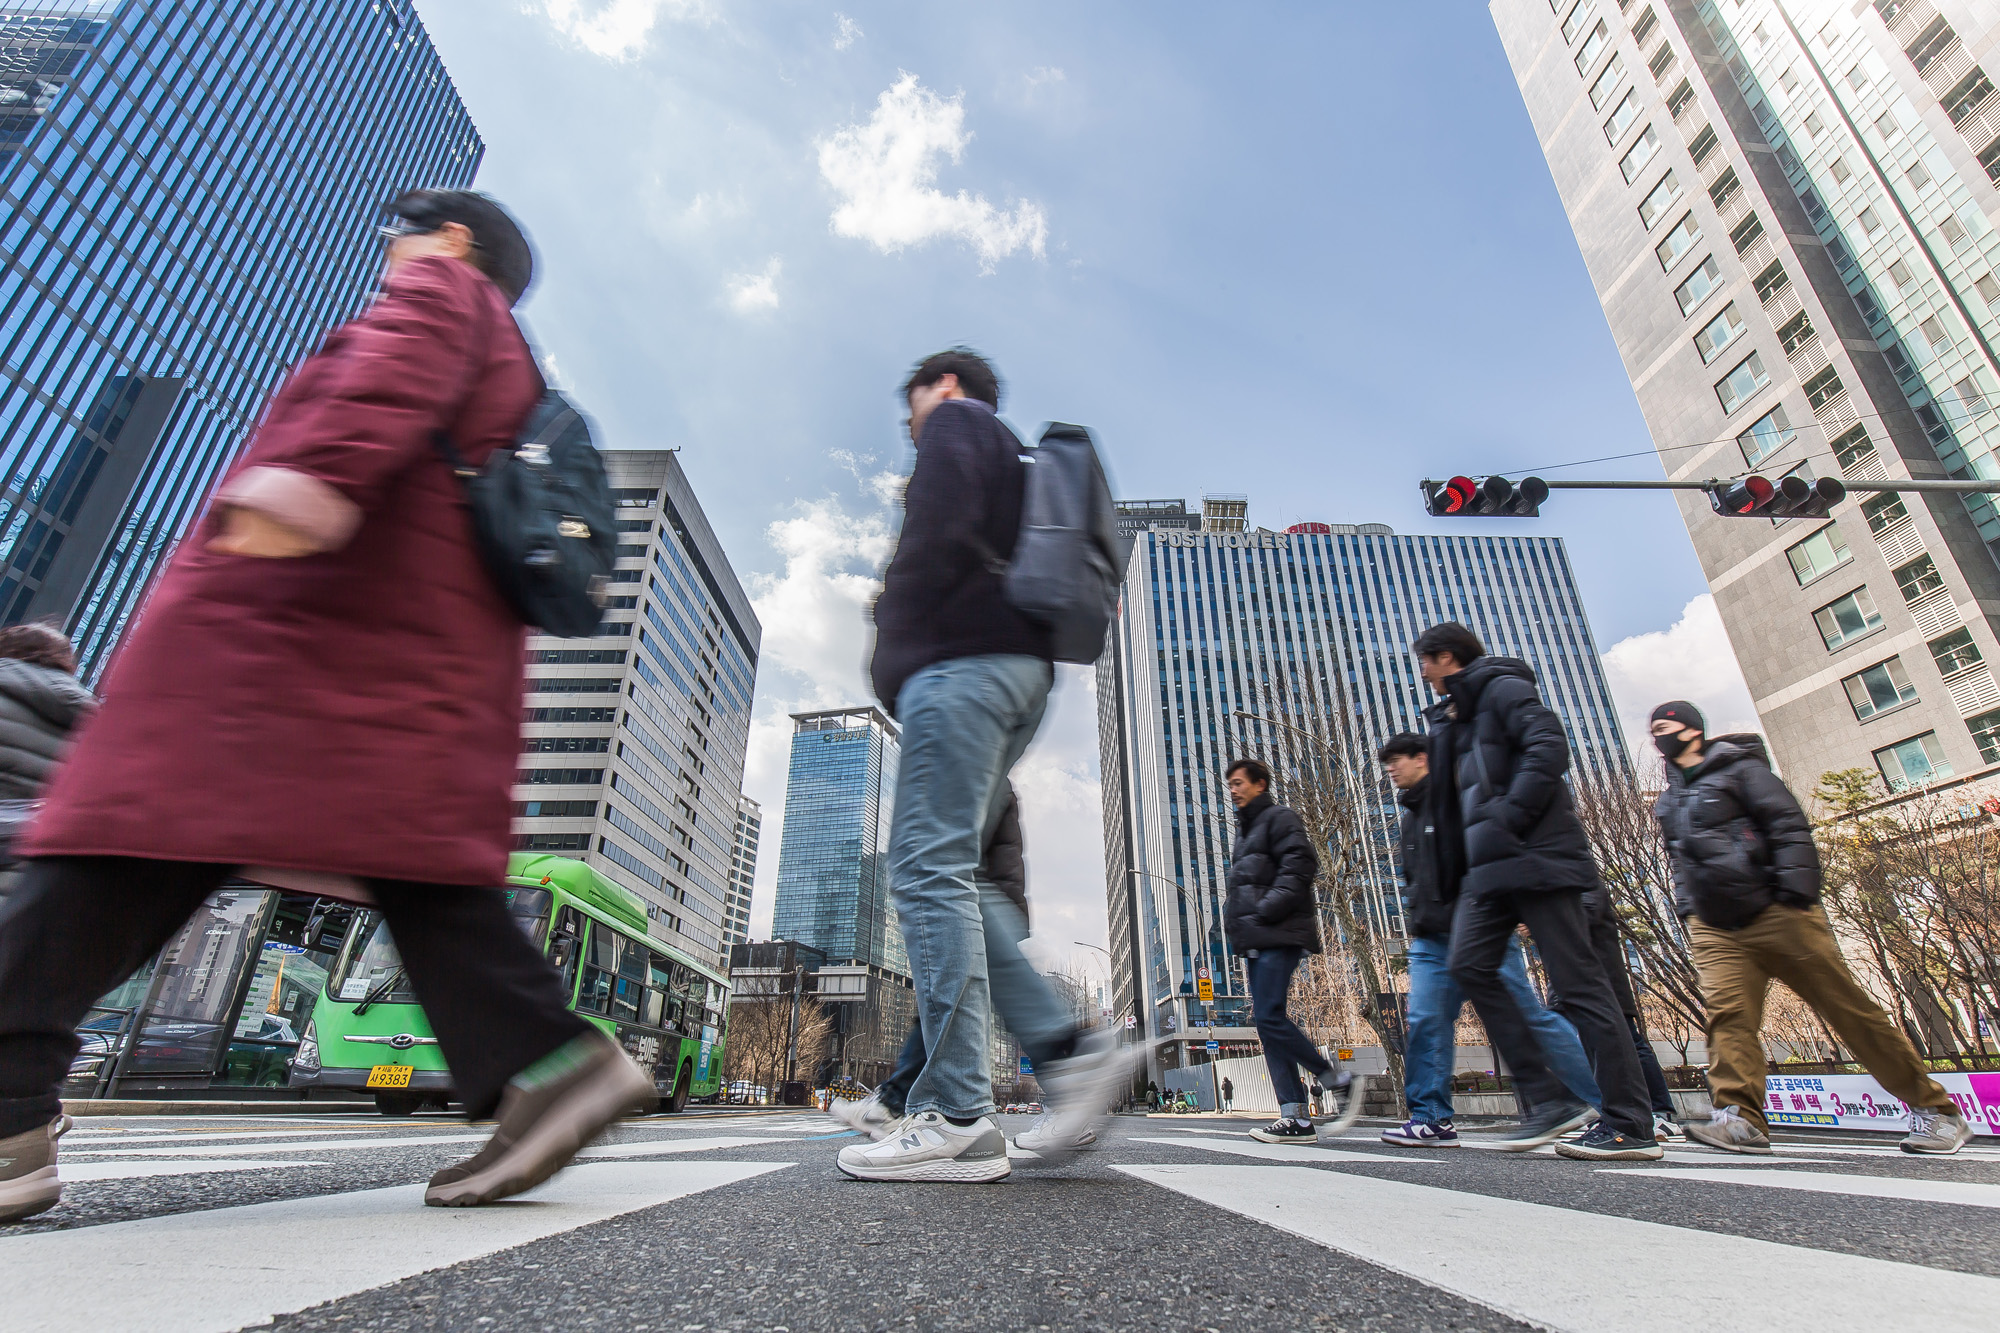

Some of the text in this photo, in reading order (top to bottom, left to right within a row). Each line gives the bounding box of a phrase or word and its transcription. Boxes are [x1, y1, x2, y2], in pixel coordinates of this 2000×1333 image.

[1115, 520, 1147, 528] HILLA
[1155, 532, 1289, 549] POST TOWER
[1765, 1078, 1825, 1092] 마포 공덕역점
[1985, 1104, 2000, 1126] 0
[899, 1133, 922, 1151] N
